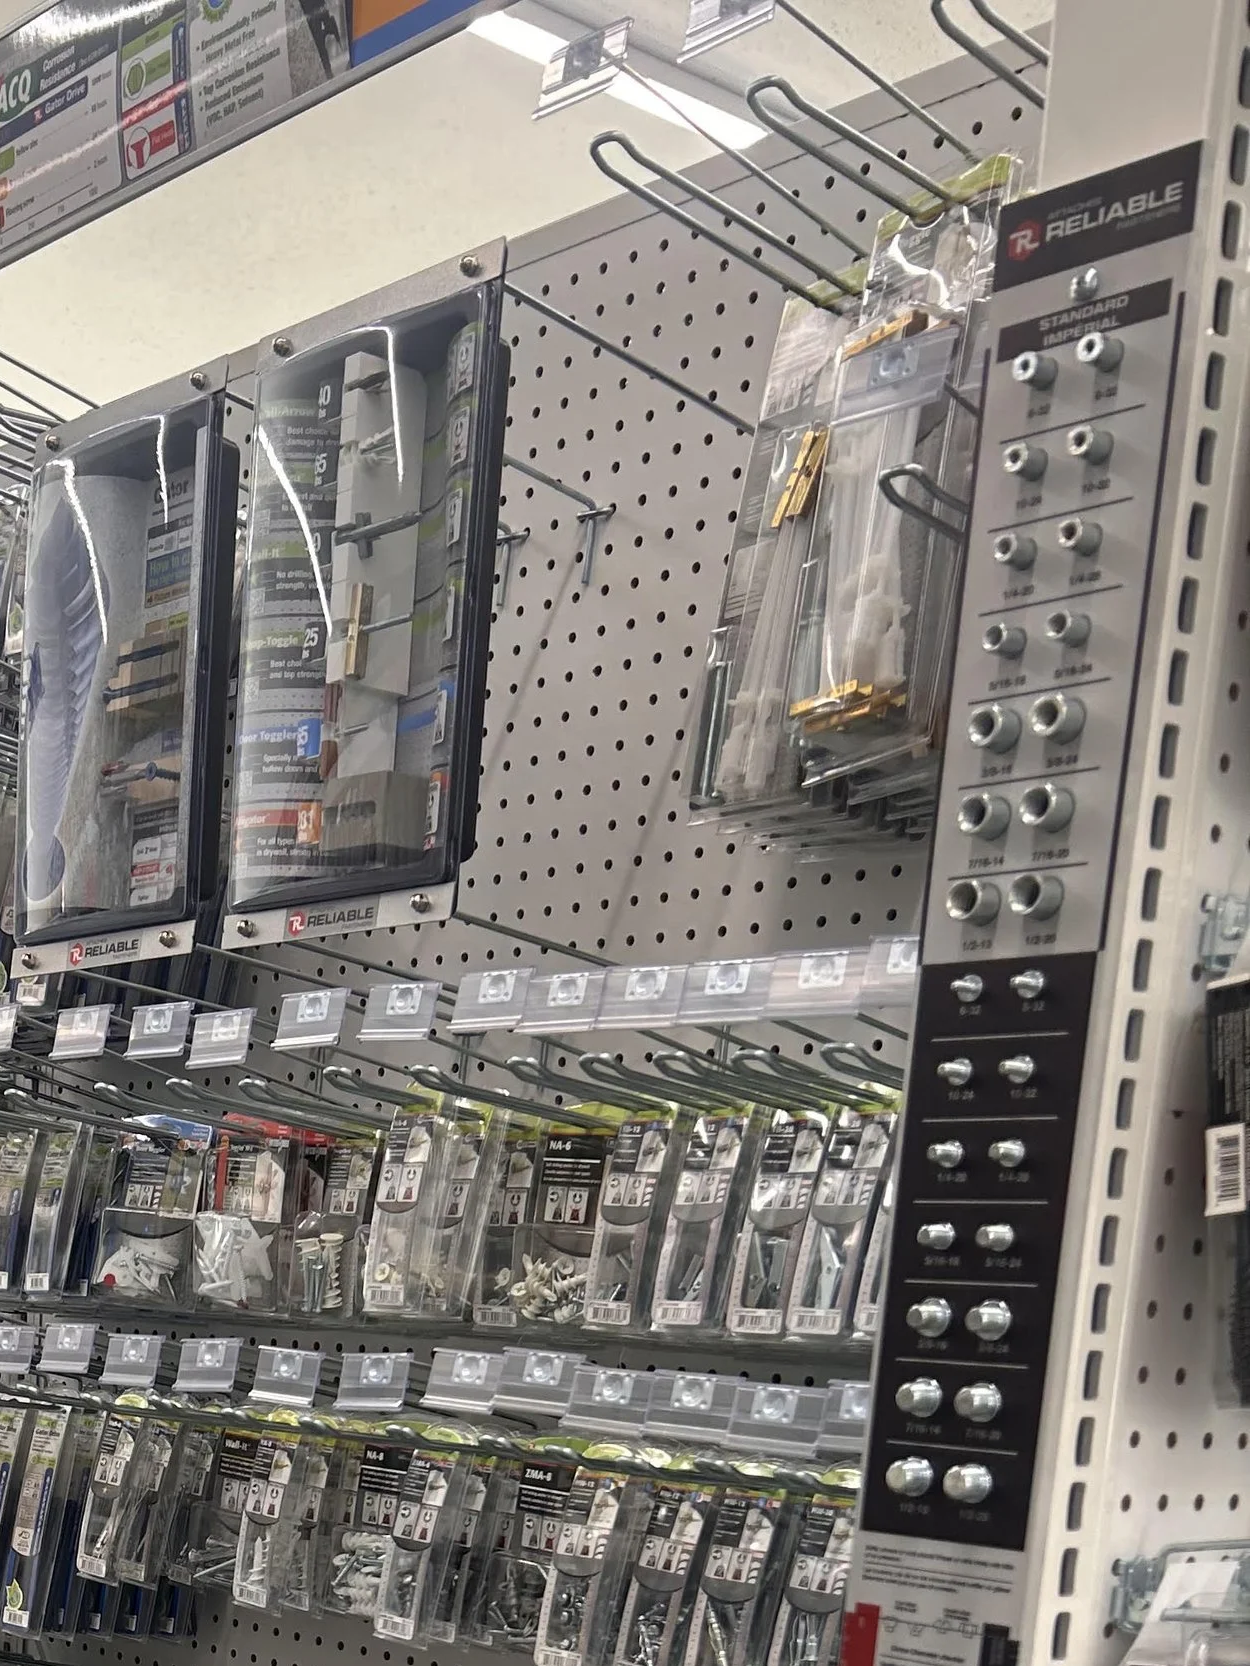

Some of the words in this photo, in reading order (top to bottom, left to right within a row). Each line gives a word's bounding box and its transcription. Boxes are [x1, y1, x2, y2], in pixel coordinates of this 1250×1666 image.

[42, 45, 76, 72] Corrosion
[39, 62, 76, 91] Resistance
[45, 94, 66, 115] Gator
[66, 83, 86, 101] Drive
[1045, 181, 1184, 243] RELIABLE
[1038, 296, 1130, 332] STANDARD
[307, 906, 374, 928] RELIABLE
[84, 939, 139, 959] RELIABLE
[549, 1141, 572, 1151] NA-6
